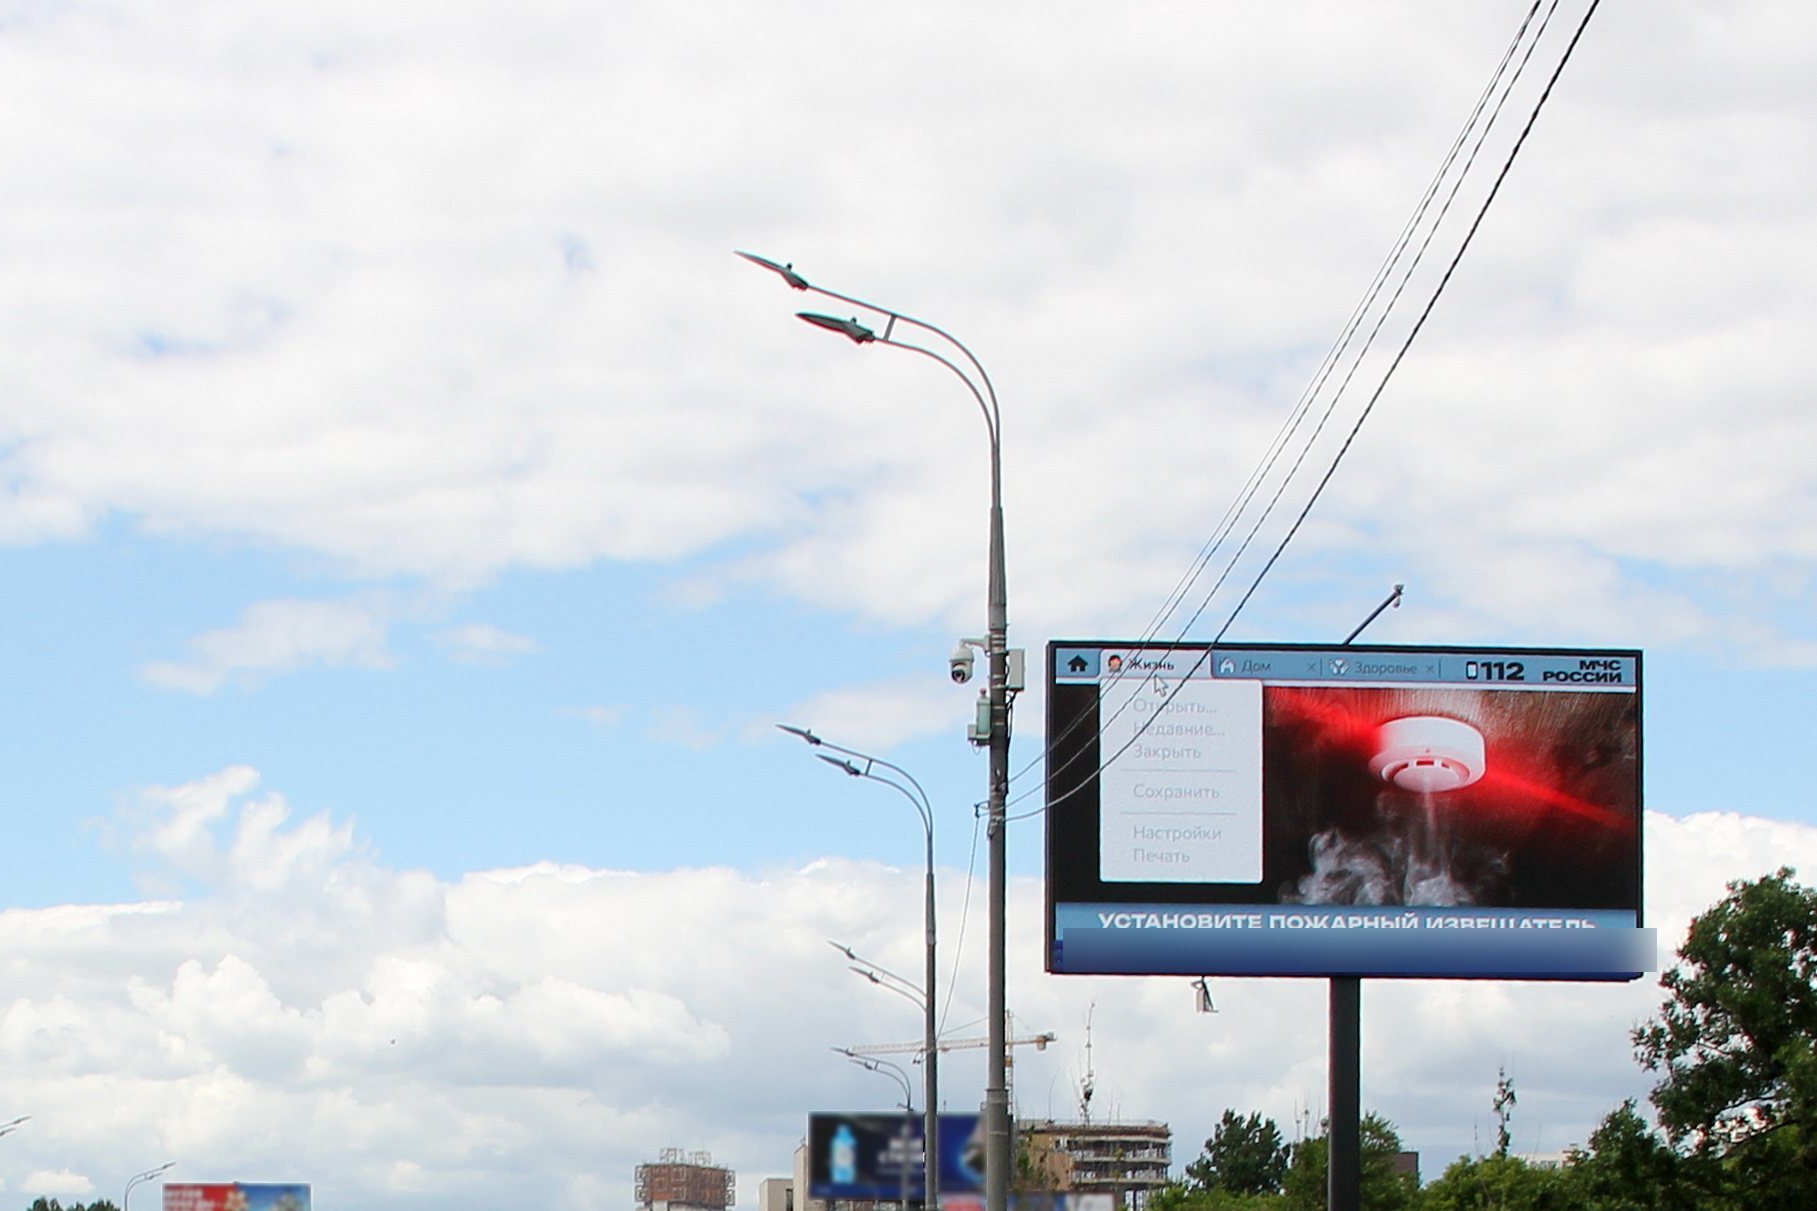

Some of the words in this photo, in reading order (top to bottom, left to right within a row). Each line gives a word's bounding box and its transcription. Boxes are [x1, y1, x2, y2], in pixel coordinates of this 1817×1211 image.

[1129, 657, 1175, 671] Жизнь
[1241, 659, 1272, 673] Дом
[1354, 661, 1418, 676] Здоровье
[1481, 661, 1525, 681] 112
[1579, 659, 1622, 671] МЧС
[1542, 671, 1623, 684] РОССИИ
[1133, 744, 1202, 761] Закрыть
[1133, 783, 1220, 801] Сохранить
[1133, 825, 1223, 842] Настройки
[1133, 849, 1190, 864] Печать
[1098, 913, 1262, 929] УСТАНОВИТЕ
[1269, 912, 1418, 929] ПОЖАРНЫЙ
